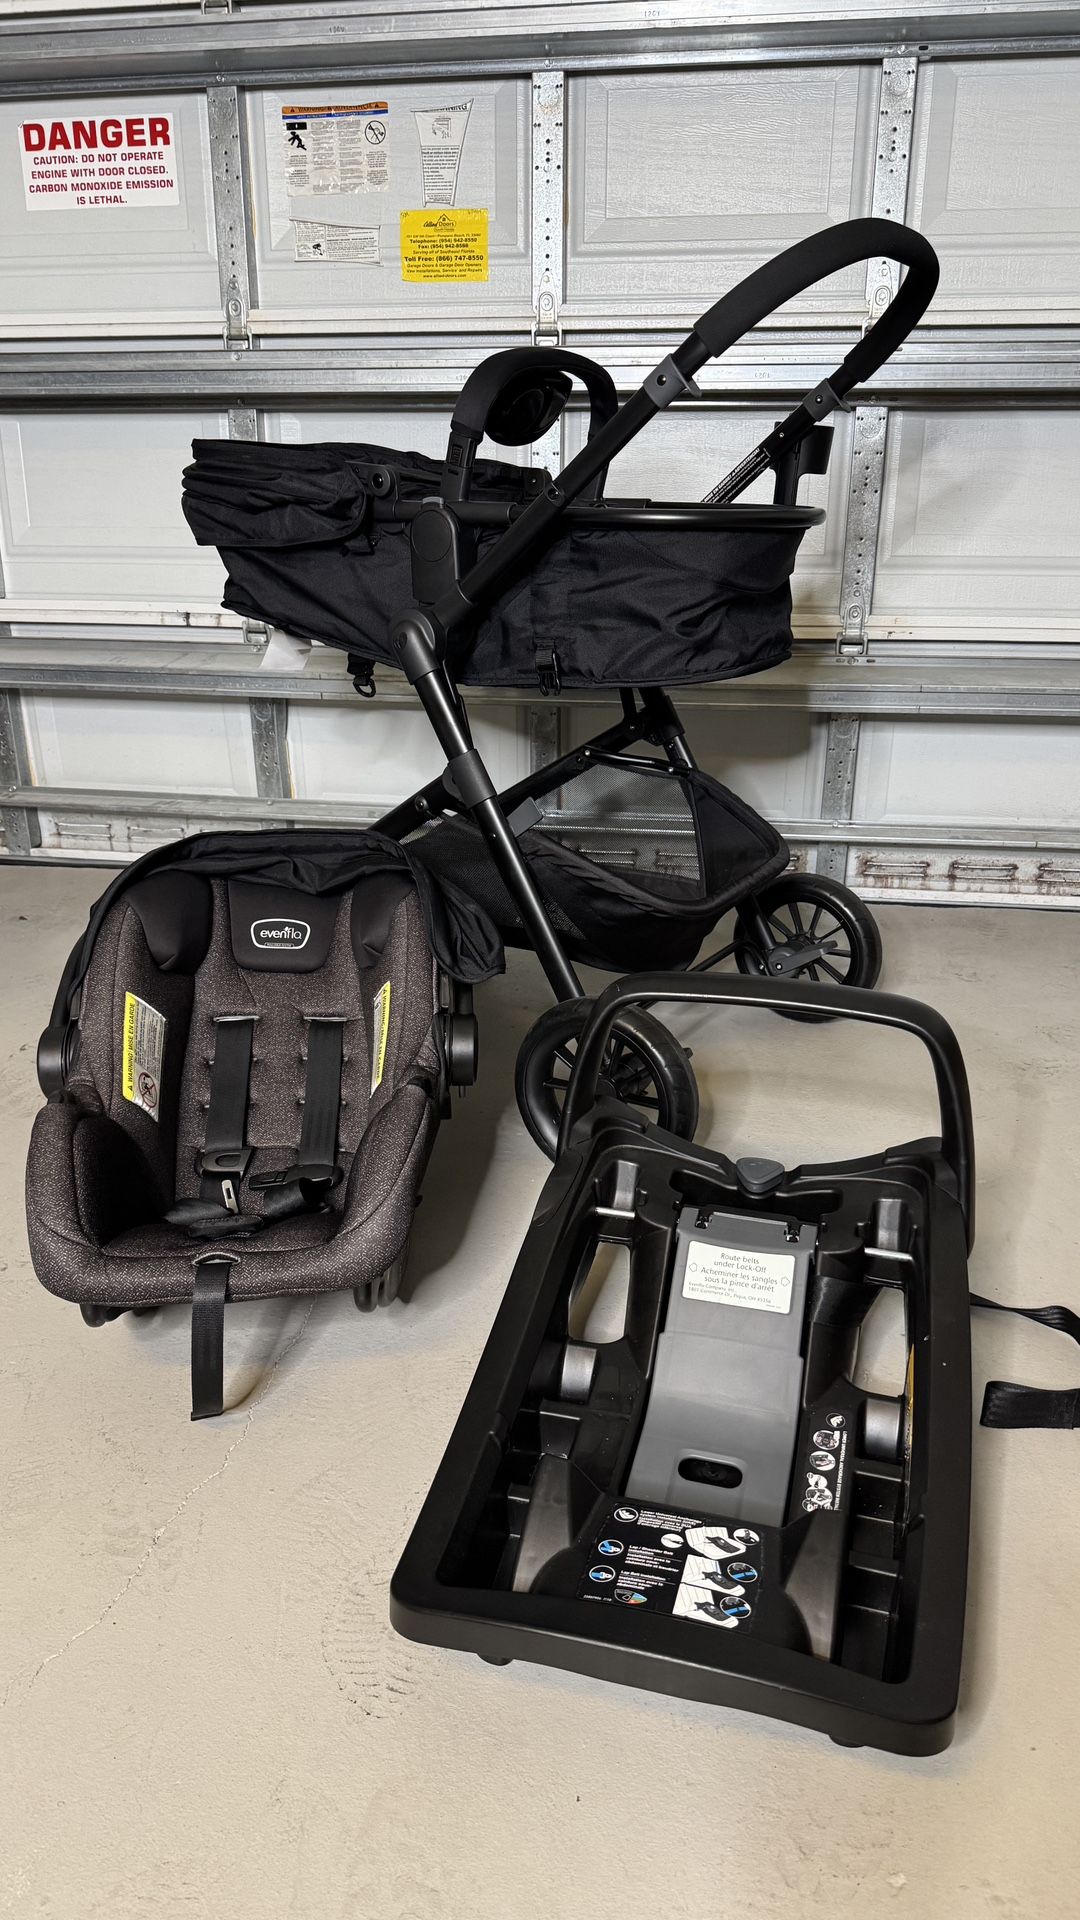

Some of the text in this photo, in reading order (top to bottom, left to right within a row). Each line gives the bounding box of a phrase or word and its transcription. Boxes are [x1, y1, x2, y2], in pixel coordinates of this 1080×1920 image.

[23, 118, 170, 152] DANGER
[34, 152, 164, 166] CAUTION: DO NOT OPERATE
[32, 166, 168, 180] ENGINE WITH DOOR CLOSED.
[29, 180, 174, 194] CARBON MONOXIDE EMISSION
[76, 195, 128, 205] IS LETHAL.
[720, 1253, 759, 1264] Route belts
[714, 1261, 766, 1273] under Lock-Off
[701, 1267, 738, 1279] Acheminer
[752, 1276, 778, 1285] sangles
[729, 1280, 749, 1289] pince
